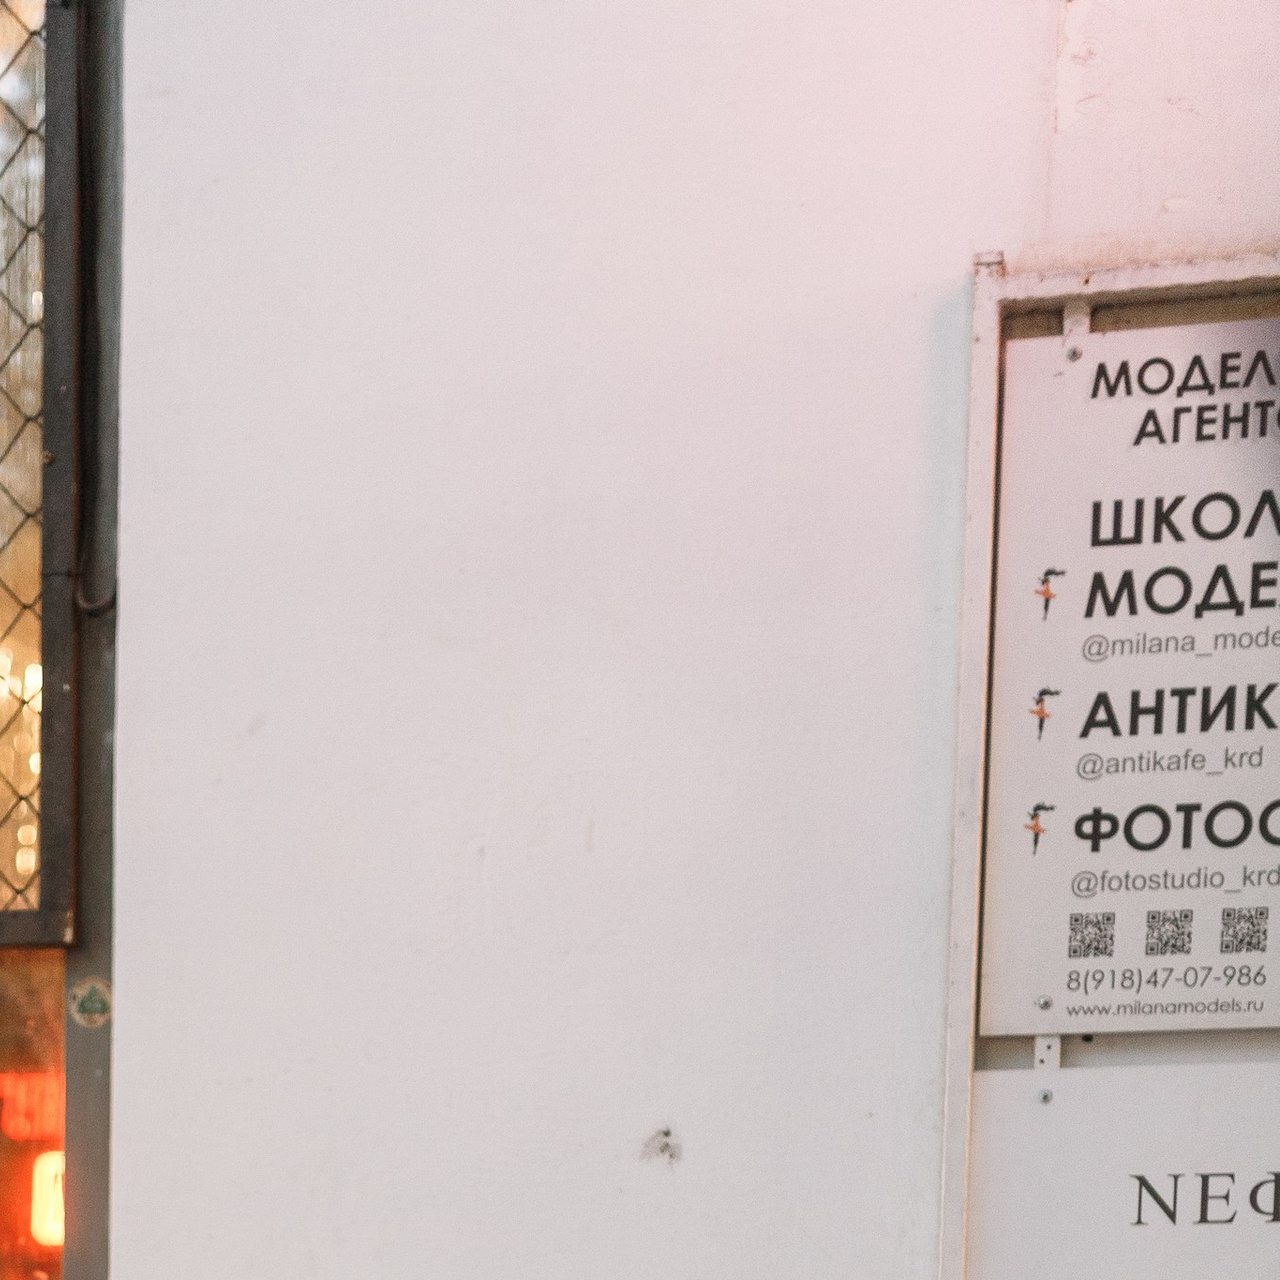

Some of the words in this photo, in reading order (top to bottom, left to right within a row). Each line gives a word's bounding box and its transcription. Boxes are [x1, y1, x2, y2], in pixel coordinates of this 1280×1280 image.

[1090, 350, 1277, 399] МОДЕЛ
[1133, 400, 1280, 446] АГЕНТ
[1091, 489, 1280, 547] ШКОЛ
[1084, 561, 1280, 619] МОДЕ
[1079, 683, 1279, 739] АНТИК
[1076, 746, 1263, 781] @antikafe_krd
[1071, 864, 1280, 898] @fotostudio_krd
[1066, 965, 1267, 995] 8(918)47-07-986
[1066, 998, 1265, 1016] www.milanamodels.ru
